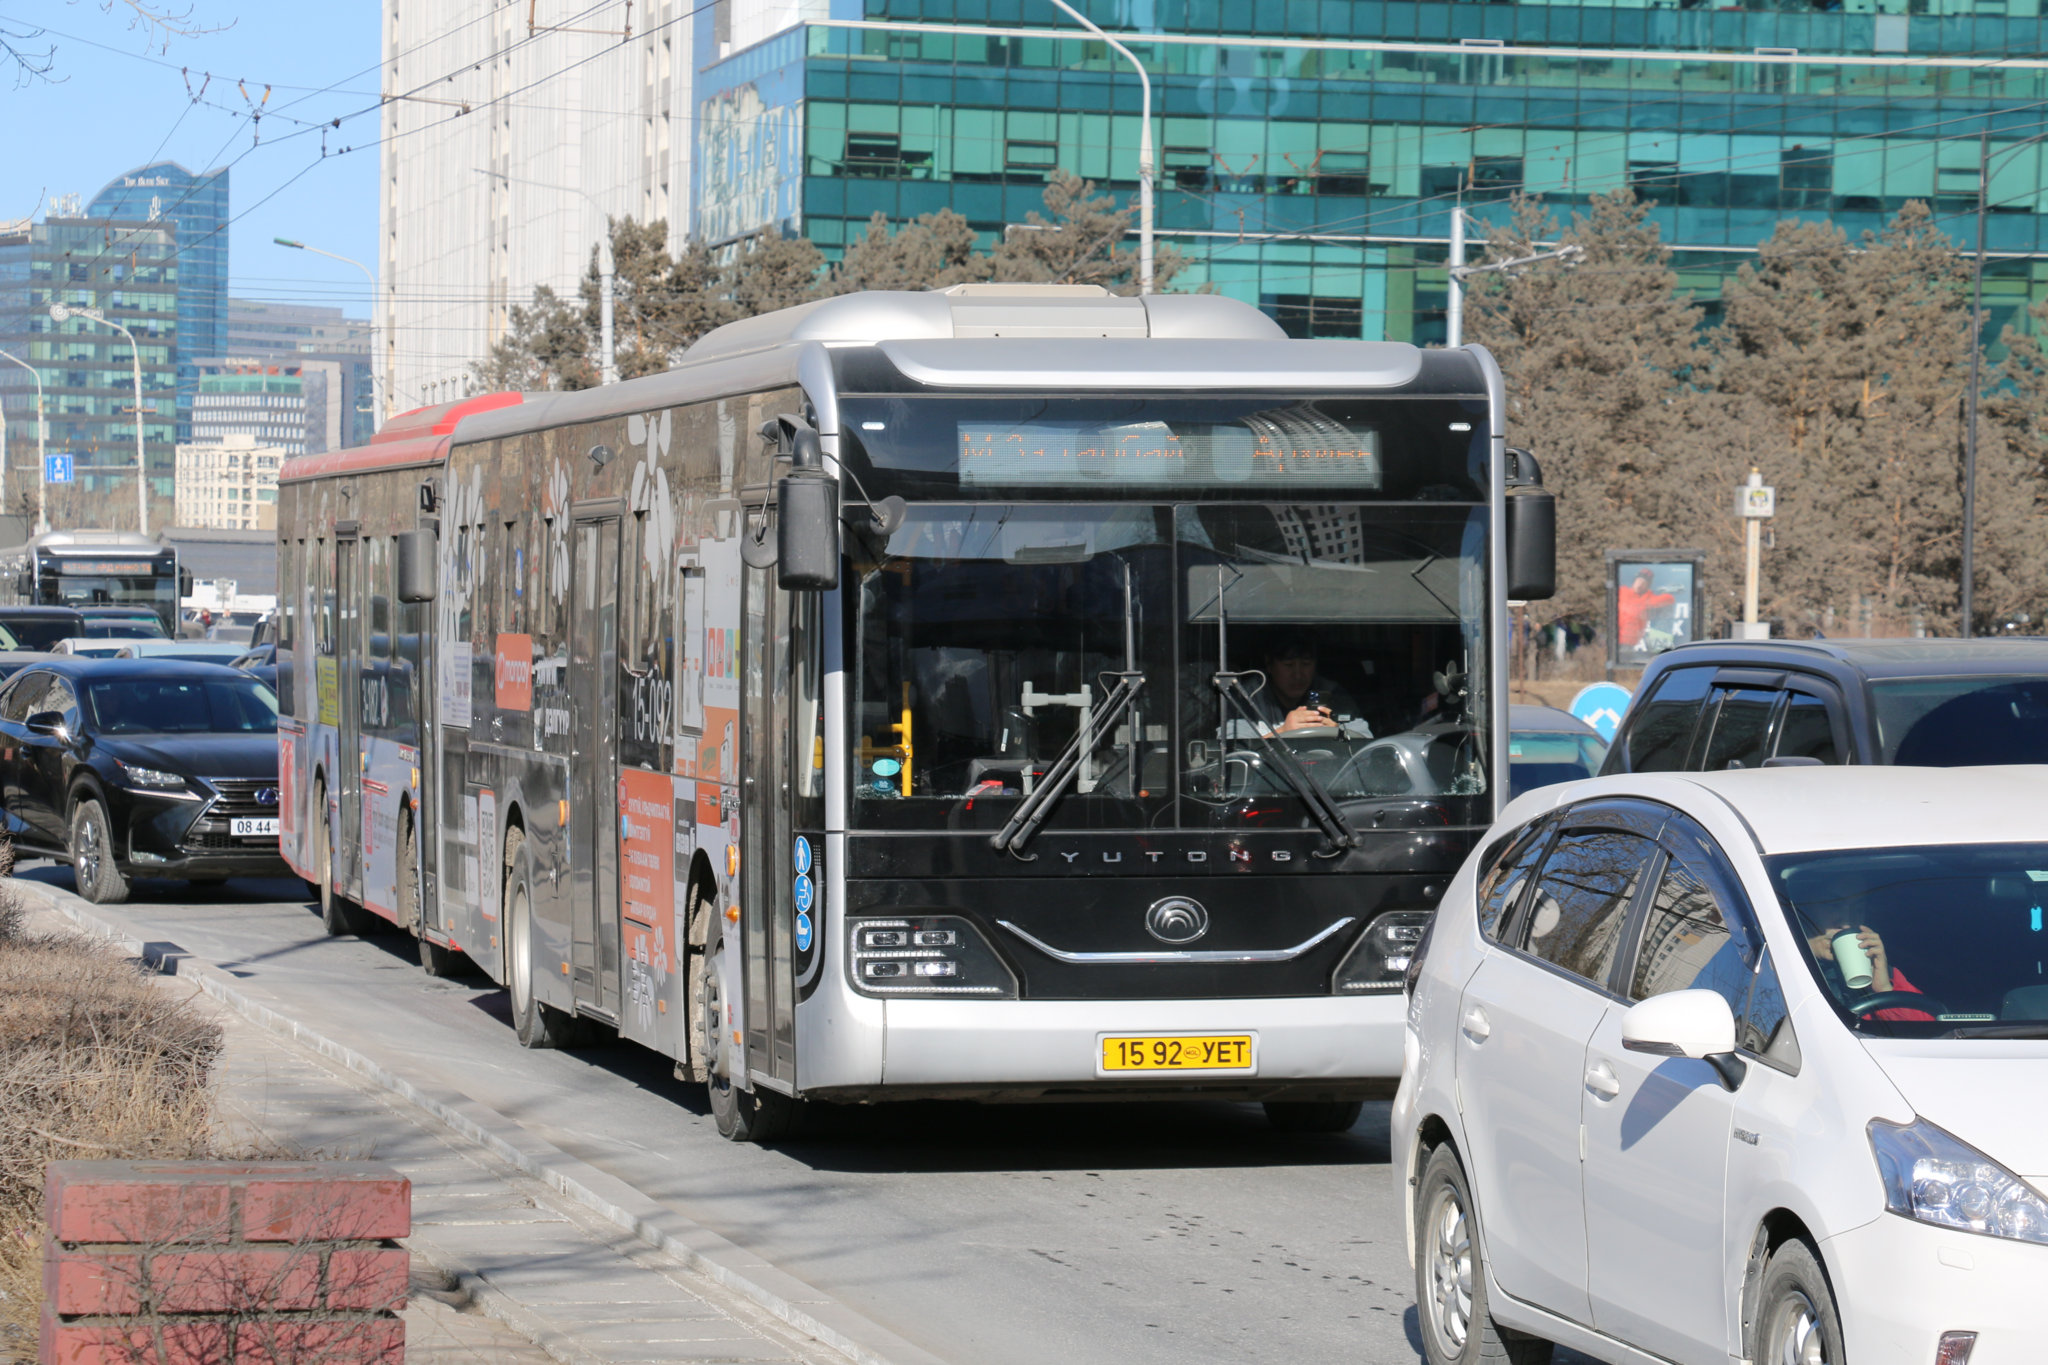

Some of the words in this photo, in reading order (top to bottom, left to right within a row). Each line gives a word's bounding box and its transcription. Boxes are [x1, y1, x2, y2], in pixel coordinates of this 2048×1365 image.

[504, 660, 530, 690] monpay
[633, 677, 672, 745] 15-092
[237, 820, 252, 834] 08
[256, 820, 271, 834] 44
[1060, 849, 1292, 863] YUTONG
[1118, 1041, 1145, 1066] 15
[1153, 1041, 1183, 1065] 92
